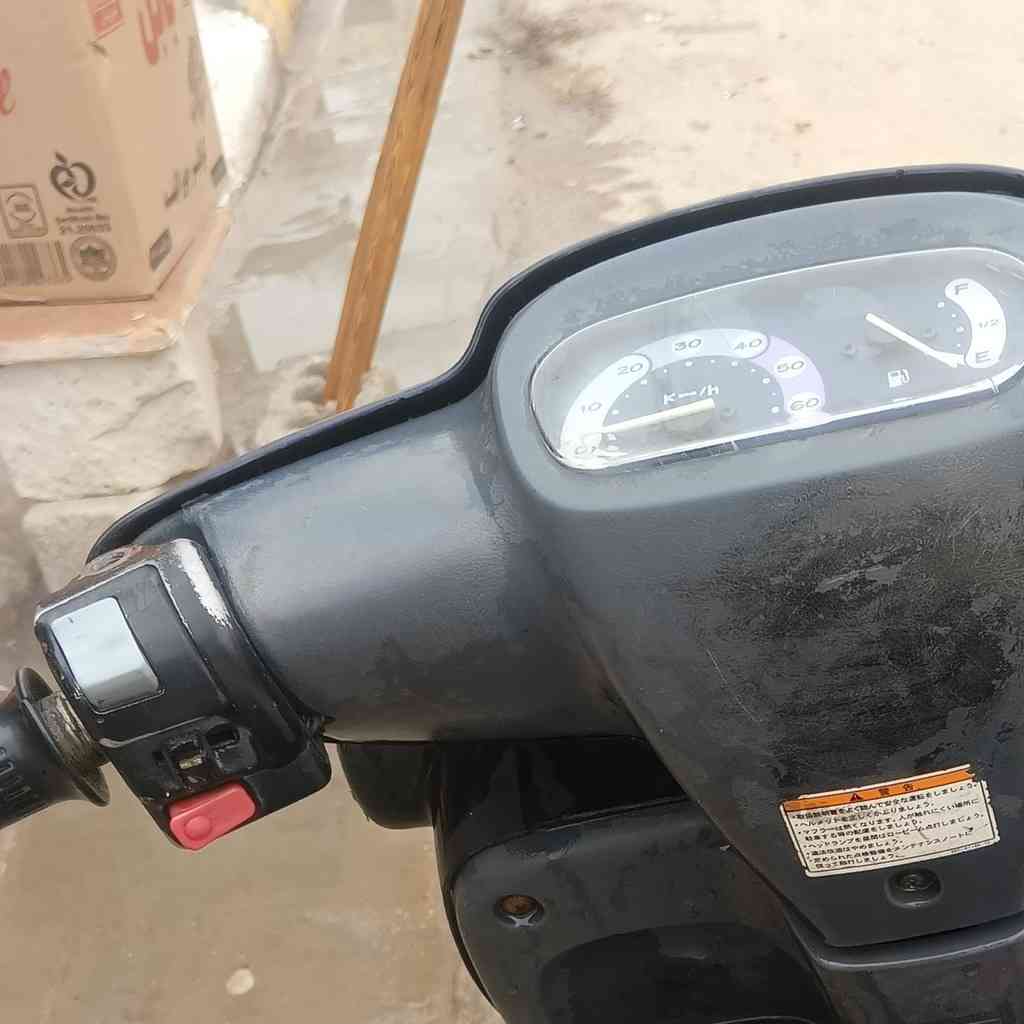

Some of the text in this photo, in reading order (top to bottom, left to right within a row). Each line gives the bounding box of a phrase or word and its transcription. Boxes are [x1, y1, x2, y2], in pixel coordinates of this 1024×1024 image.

[954, 283, 969, 295] F
[674, 338, 702, 352] 30
[734, 338, 762, 350] 40
[975, 350, 992, 364] E
[617, 363, 643, 376] 20
[777, 360, 805, 373] 50
[580, 402, 602, 415] 10
[790, 397, 820, 411] 60
